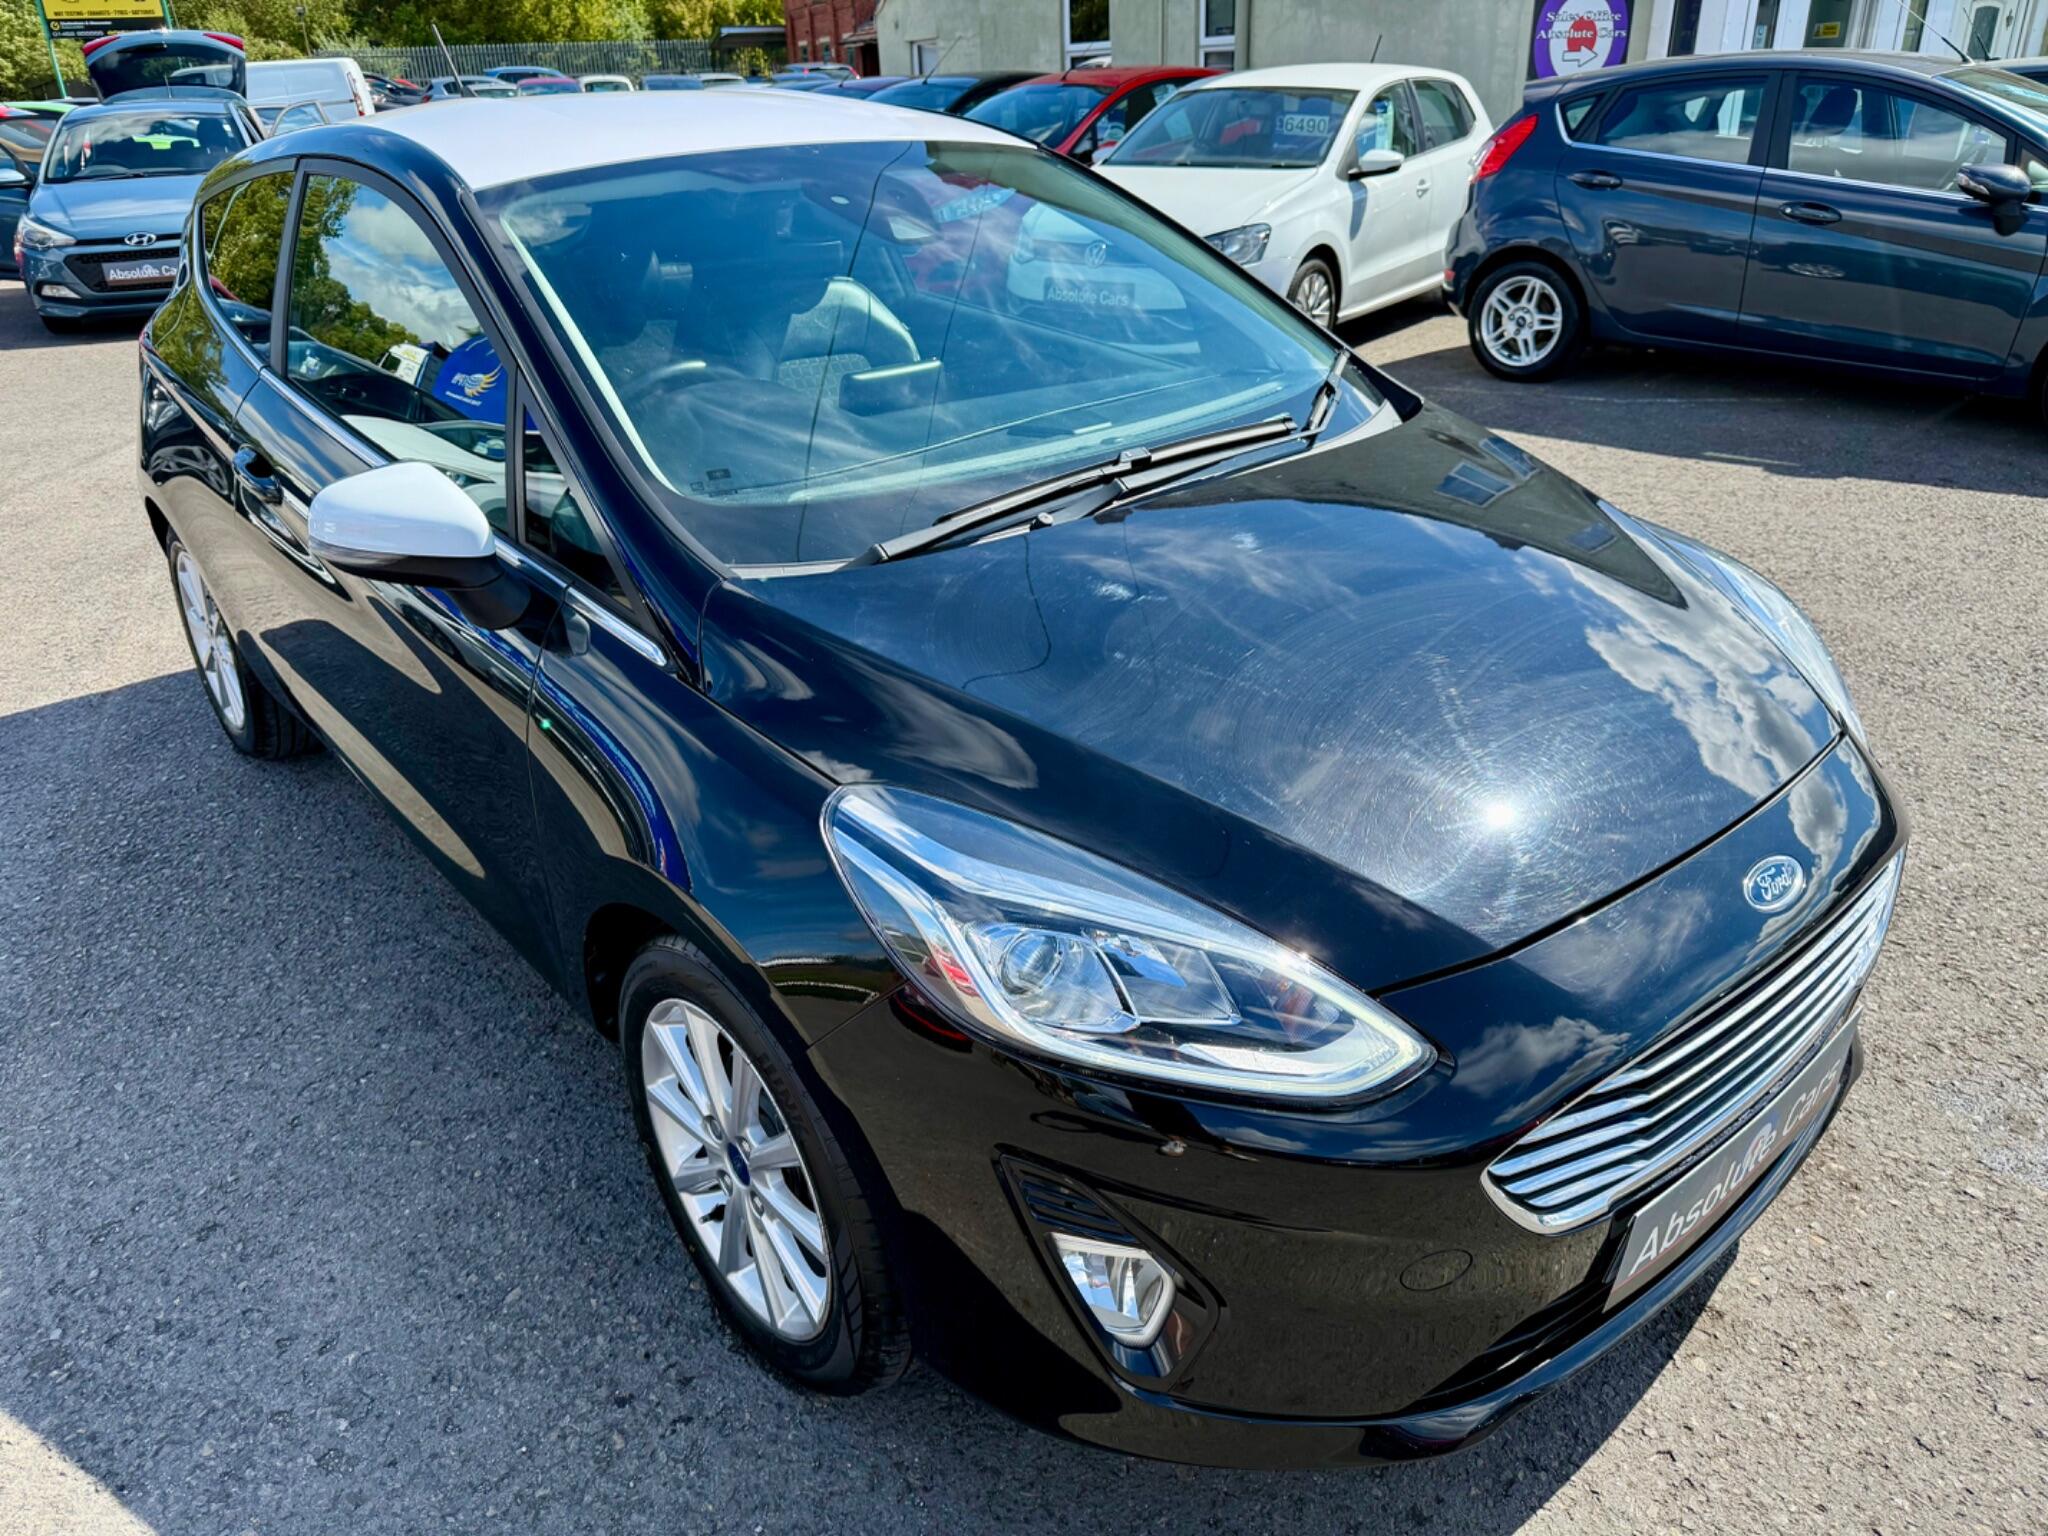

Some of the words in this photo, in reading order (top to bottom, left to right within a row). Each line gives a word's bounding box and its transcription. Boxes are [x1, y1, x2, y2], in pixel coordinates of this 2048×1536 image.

[1546, 11, 1582, 22] Sales
[1584, 9, 1622, 22] Office
[1536, 28, 1594, 40] Absolute
[1597, 28, 1627, 39] Cars
[161, 265, 178, 276] Ca
[1099, 290, 1130, 306] Cars
[1756, 866, 1793, 901] Ford
[1629, 1123, 1778, 1277] Absolute
[1782, 1059, 1841, 1137] Cars
